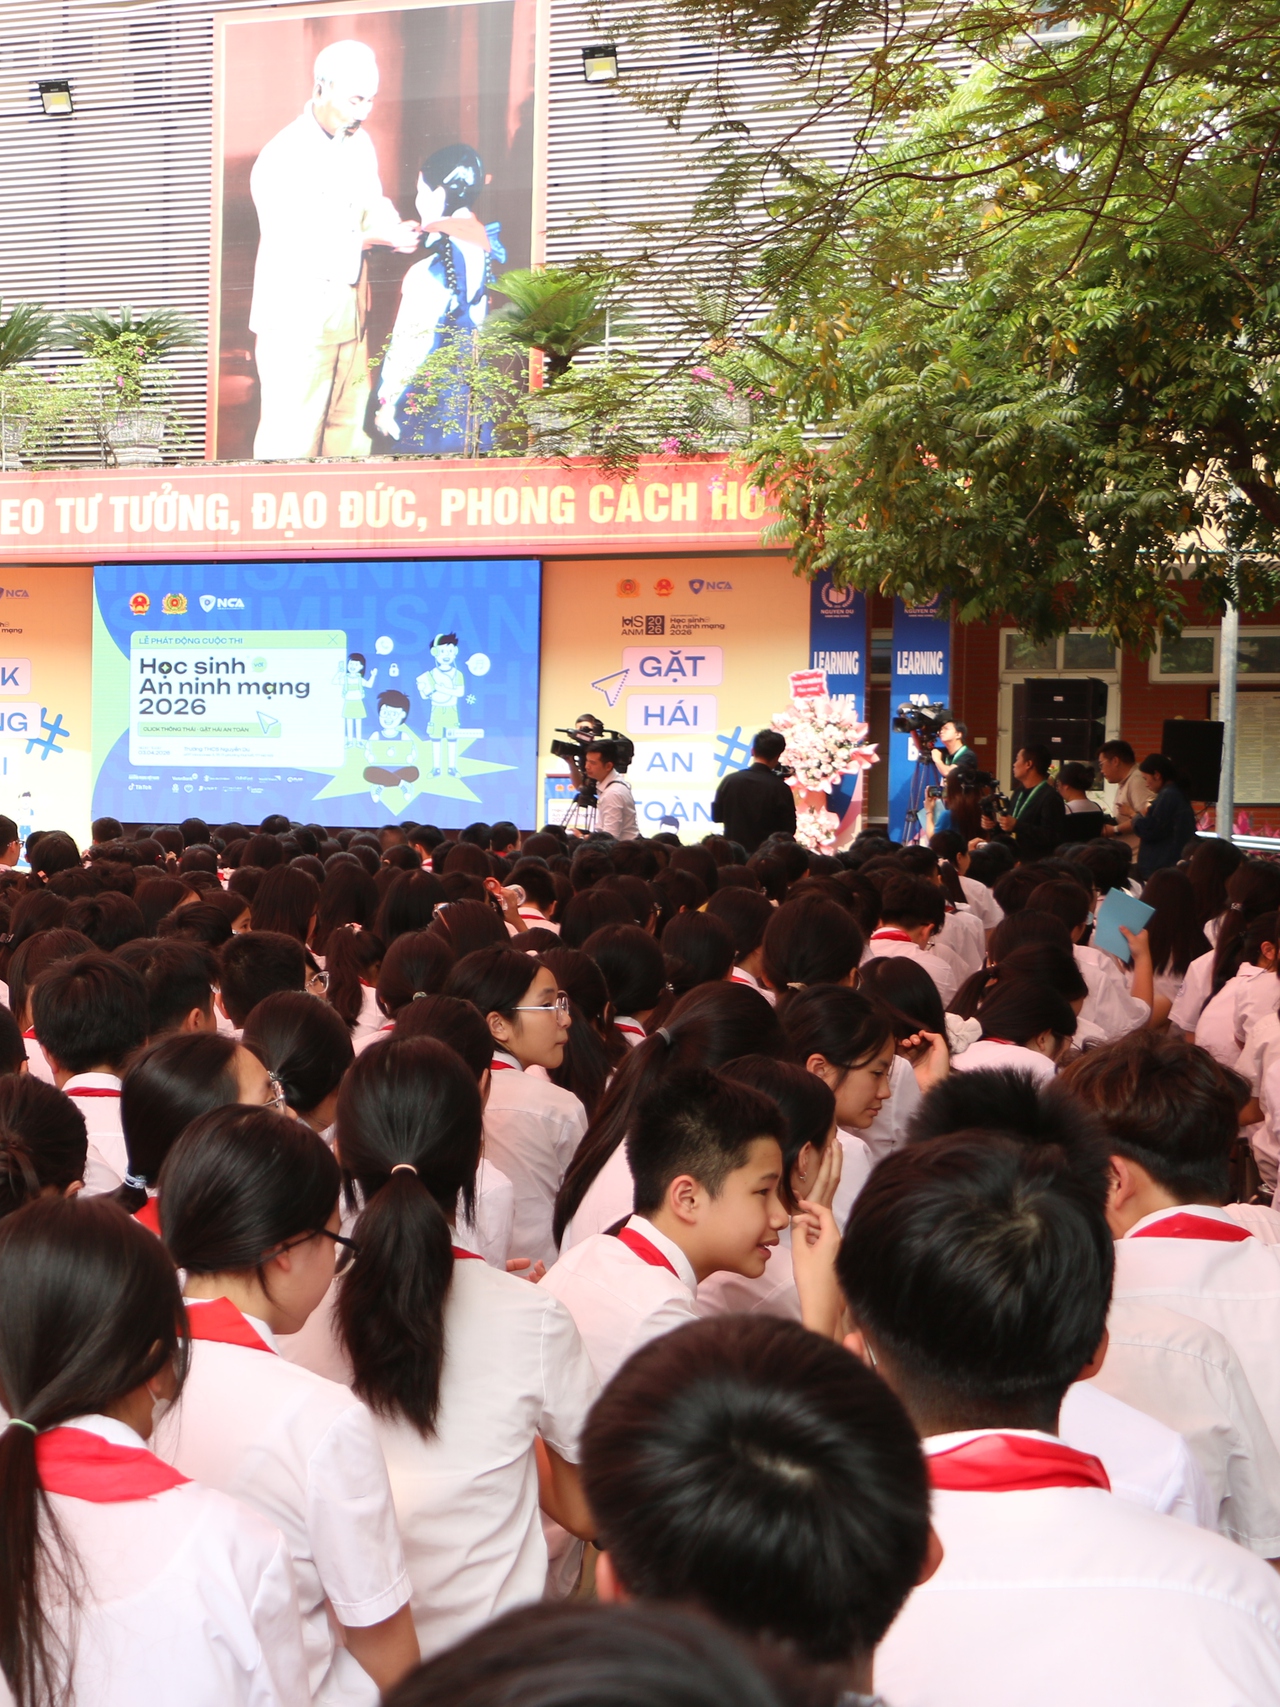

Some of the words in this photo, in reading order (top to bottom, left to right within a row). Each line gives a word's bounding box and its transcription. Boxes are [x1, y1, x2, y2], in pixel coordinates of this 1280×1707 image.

[55, 492, 103, 534] TƯ
[109, 481, 240, 535] TƯỞNG,
[251, 490, 328, 538] ĐẠO
[338, 482, 428, 532] ĐỨC,
[440, 485, 575, 526] PHONG
[6, 589, 30, 598] NCA
[706, 581, 733, 590] NCA
[217, 597, 245, 608] NCA
[151, 636, 173, 645] PHÁT
[175, 636, 200, 645] ĐỘNG
[202, 636, 227, 645] CUỘC
[229, 637, 243, 645] THI
[621, 628, 644, 636] ANM
[139, 658, 188, 680] Học
[194, 656, 246, 675] sinh
[639, 650, 706, 683] GẶT
[896, 651, 944, 675] LEARNING
[139, 678, 172, 695] An
[179, 677, 231, 695] ninh
[237, 681, 311, 700] mạng
[138, 698, 207, 716] 2026
[643, 699, 699, 726] HÁI
[645, 752, 693, 772] AN
